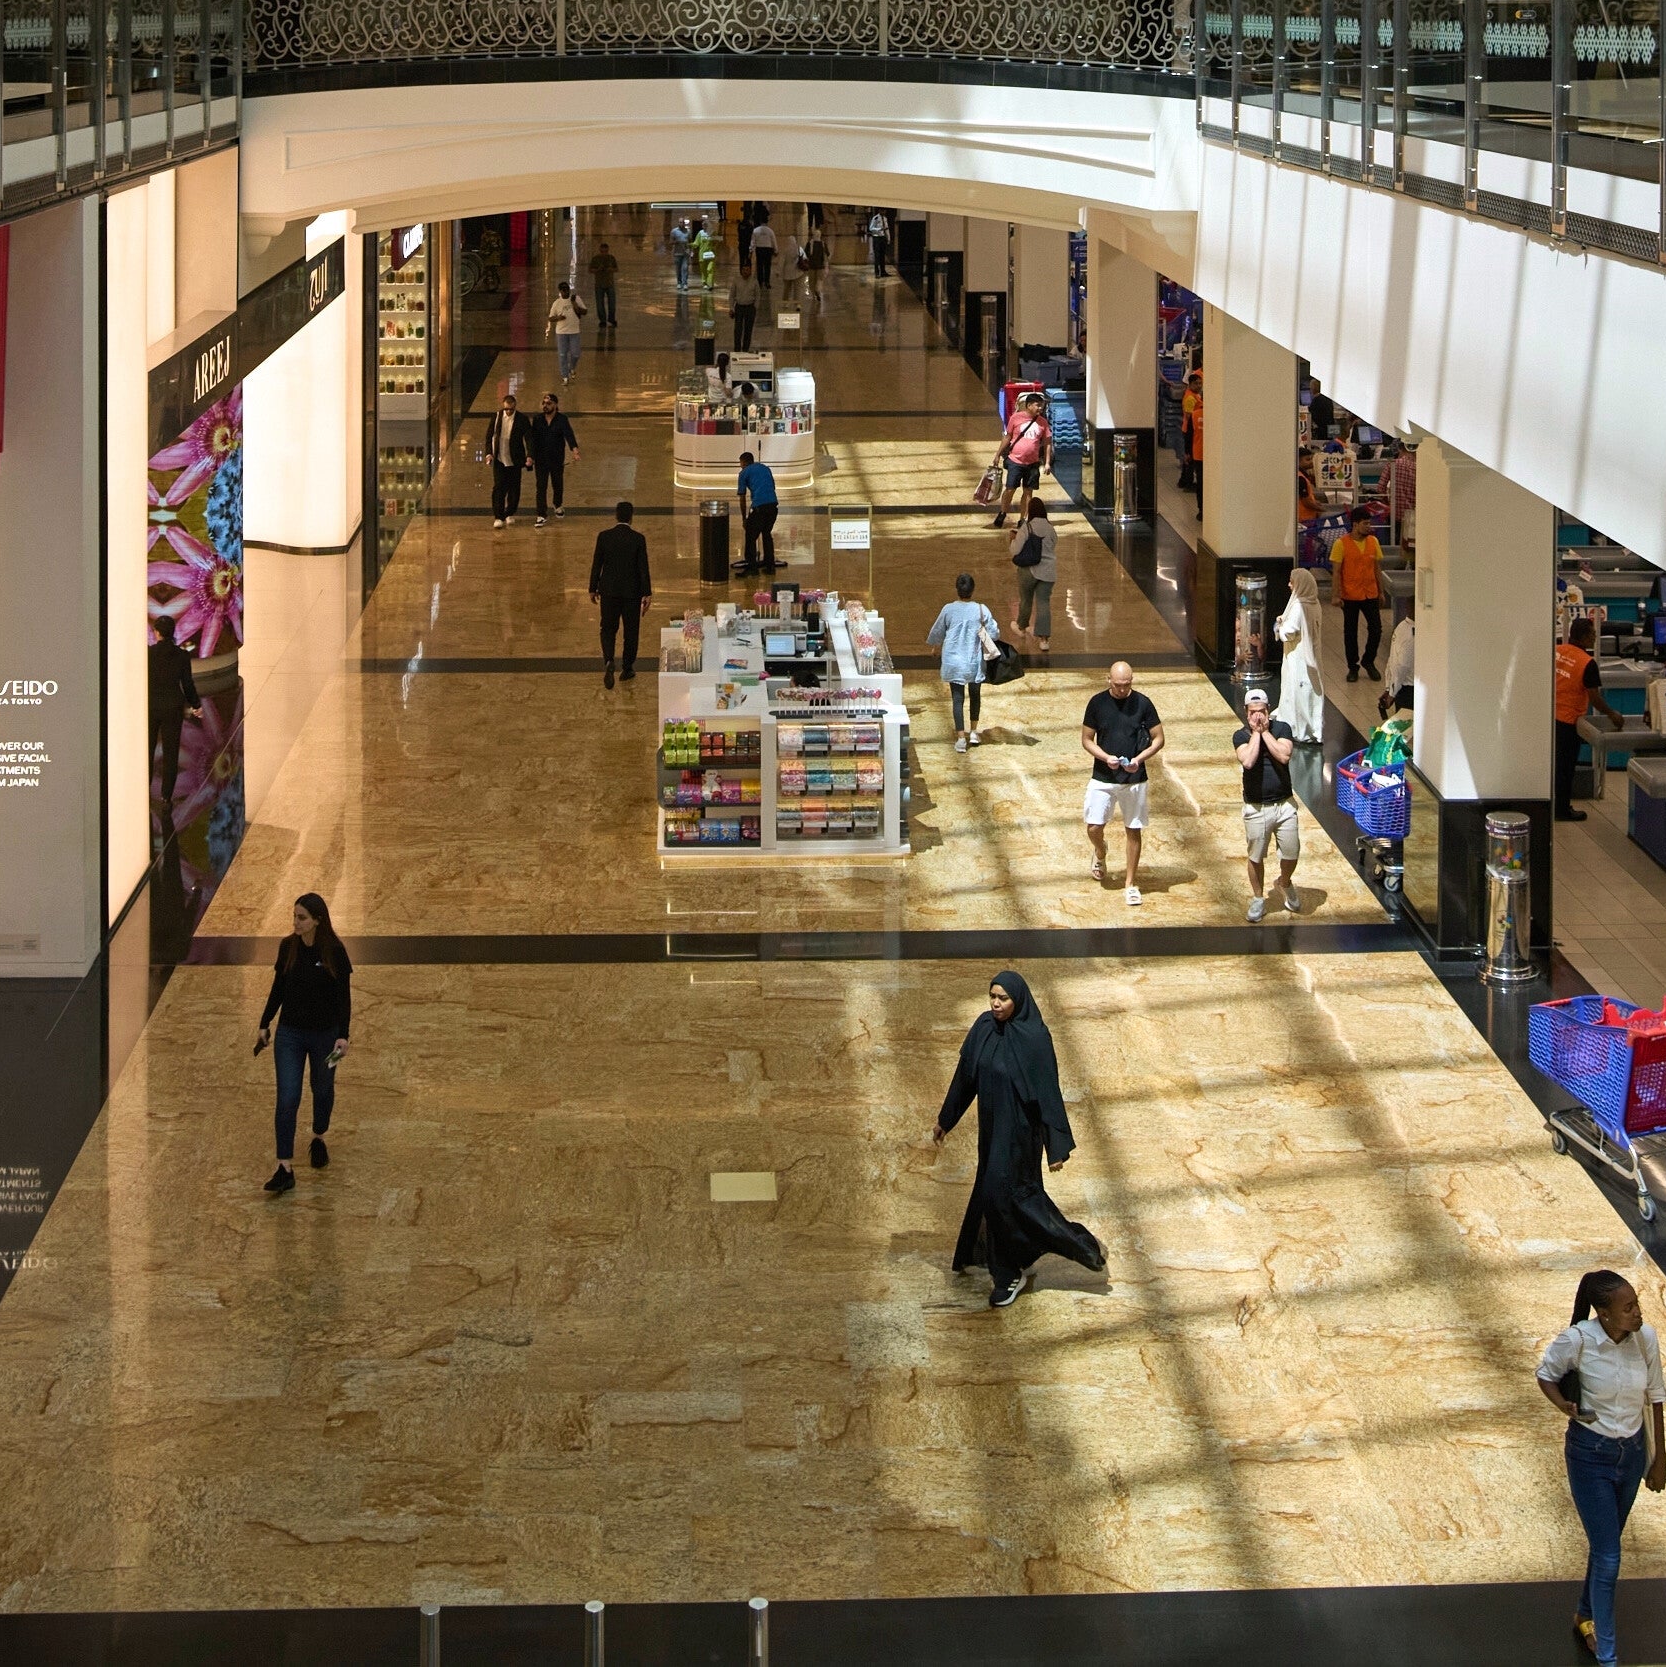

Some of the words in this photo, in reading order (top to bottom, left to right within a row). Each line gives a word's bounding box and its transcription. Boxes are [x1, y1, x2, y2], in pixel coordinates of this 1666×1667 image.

[193, 335, 231, 404] AREEJ
[11, 698, 43, 706] TOKYO
[22, 741, 44, 751] OUR
[18, 754, 52, 763] FACIAL
[7, 778, 40, 787] JAPAN
